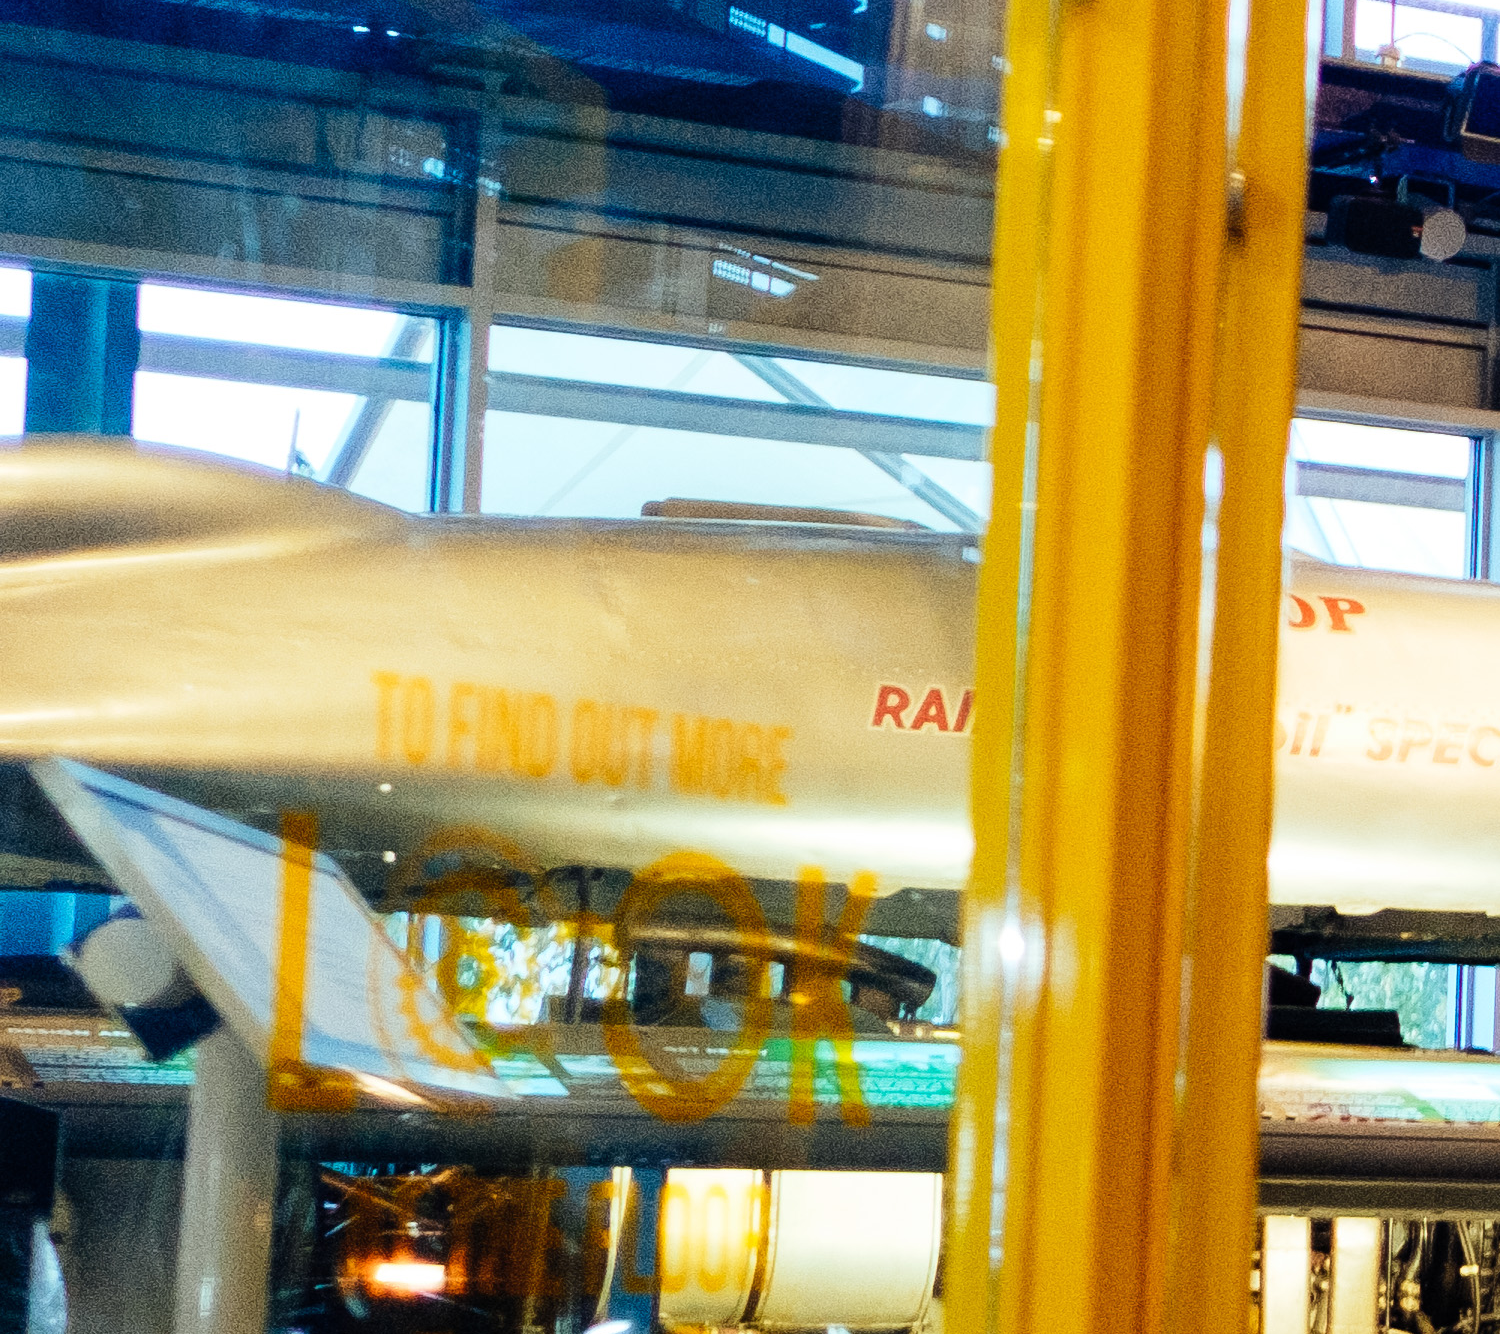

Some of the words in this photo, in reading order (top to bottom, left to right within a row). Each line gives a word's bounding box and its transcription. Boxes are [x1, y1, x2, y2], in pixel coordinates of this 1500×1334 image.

[1288, 593, 1366, 633] OP
[871, 684, 975, 733] RAI
[371, 670, 435, 764] TO
[446, 681, 558, 778] FIND
[570, 698, 661, 788] OUT
[667, 712, 796, 808] MORE
